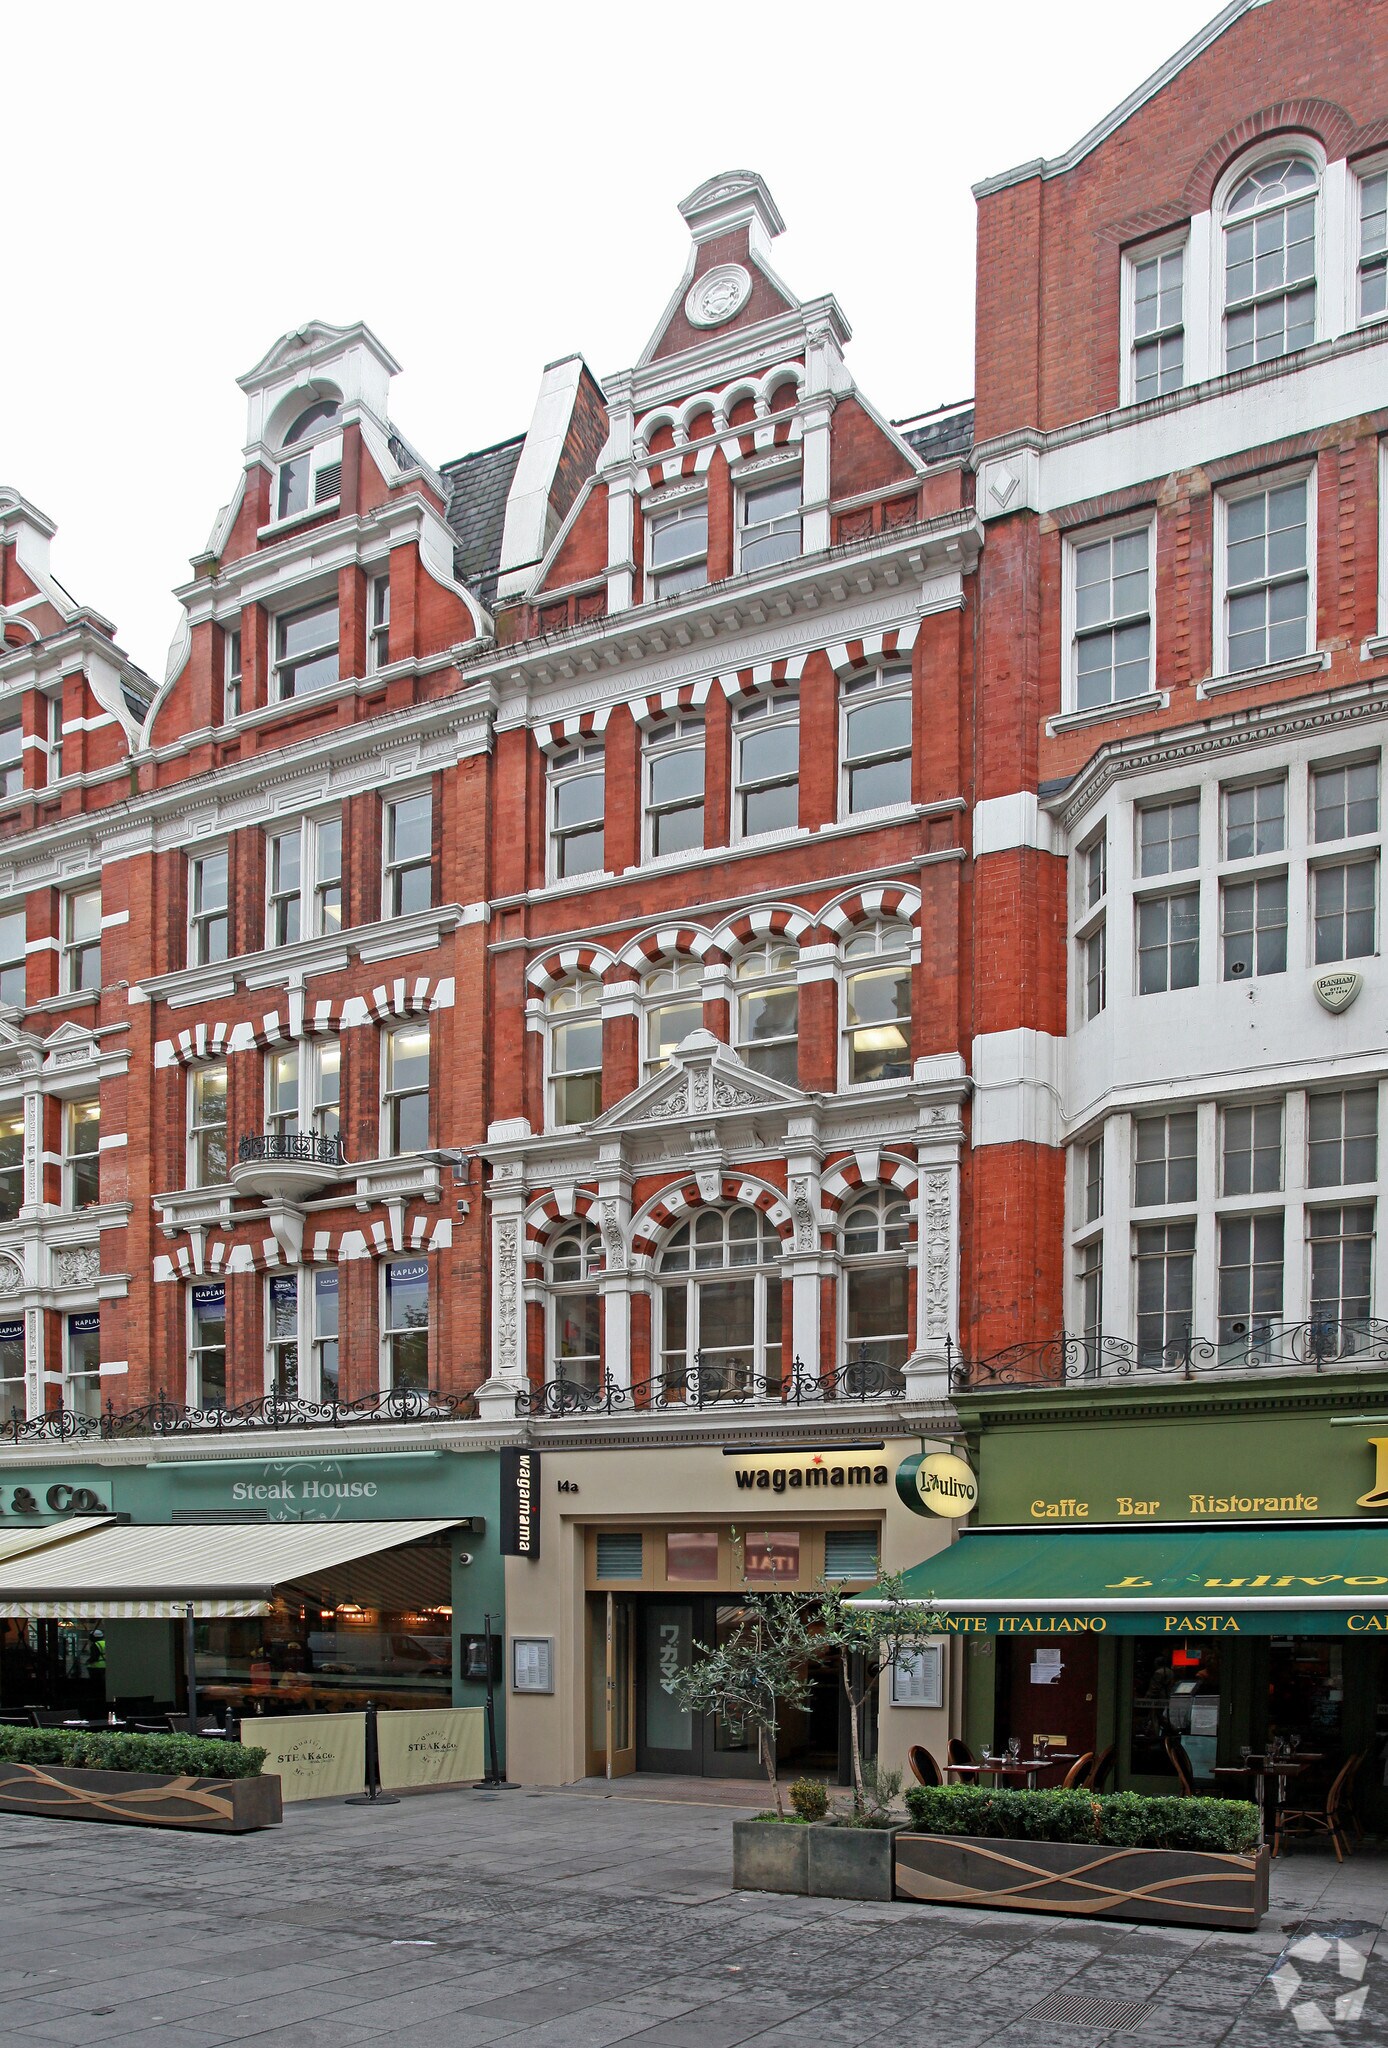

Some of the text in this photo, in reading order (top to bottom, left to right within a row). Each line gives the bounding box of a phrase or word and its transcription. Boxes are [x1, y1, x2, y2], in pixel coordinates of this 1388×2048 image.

[1320, 976, 1353, 988] BANHAM
[390, 1266, 424, 1277] KAPLAN
[195, 1289, 225, 1298] KAPLAN
[557, 1480, 579, 1492] 14a
[735, 1464, 888, 1493] wagamama
[232, 1480, 378, 1500] Steak House
[11, 1487, 39, 1513] &
[46, 1484, 107, 1512] Co.
[517, 1455, 531, 1551] wagamama
[1030, 1493, 1319, 1518] Caffe Bar Ristorante
[998, 1616, 1107, 1632] ITALIANO
[1164, 1616, 1241, 1631] PASTA
[969, 1641, 993, 1657] 14
[408, 1742, 440, 1752] STEAK
[277, 1752, 315, 1763] STEAK
